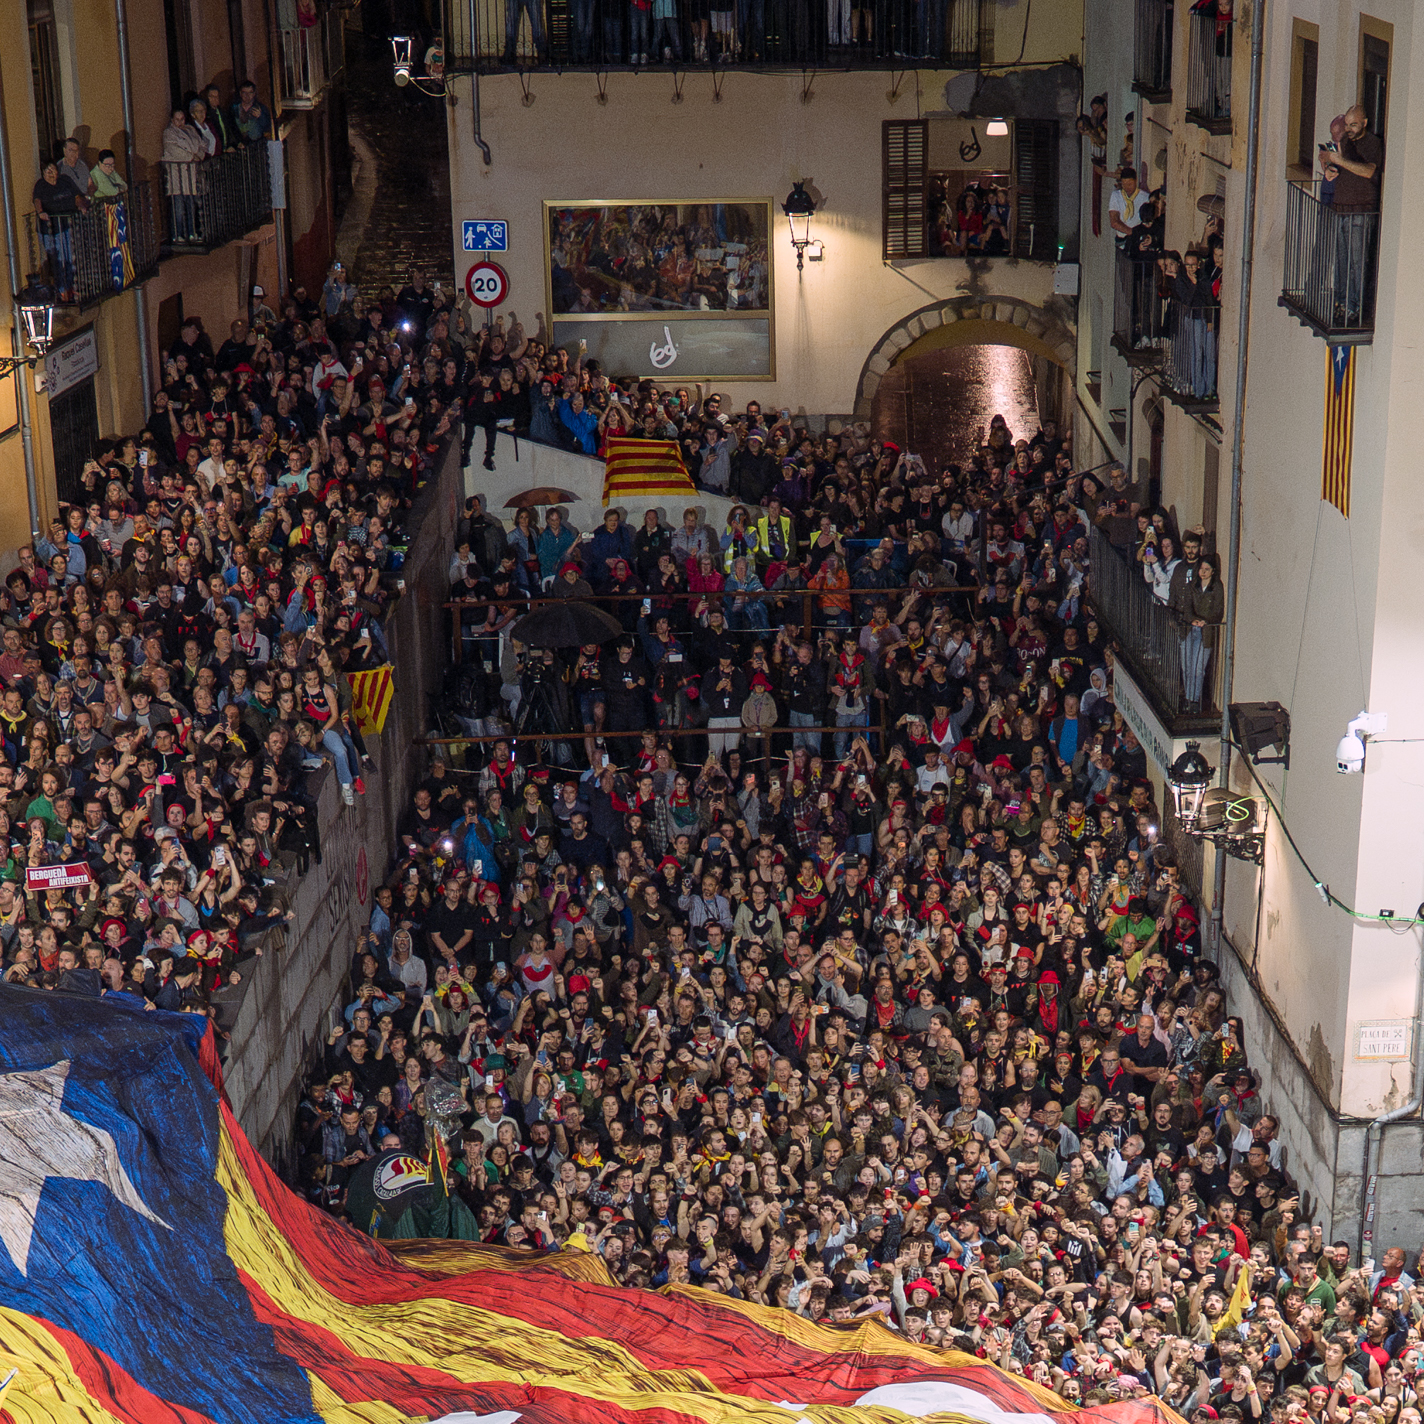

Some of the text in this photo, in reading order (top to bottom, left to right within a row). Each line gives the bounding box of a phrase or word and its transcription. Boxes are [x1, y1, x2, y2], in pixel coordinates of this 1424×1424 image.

[474, 278, 498, 292] 20
[49, 874, 88, 886] ANTIFEIXISTA
[1361, 1030, 1389, 1040] PLAÇA DE
[1363, 1043, 1400, 1054] SANT PERE
